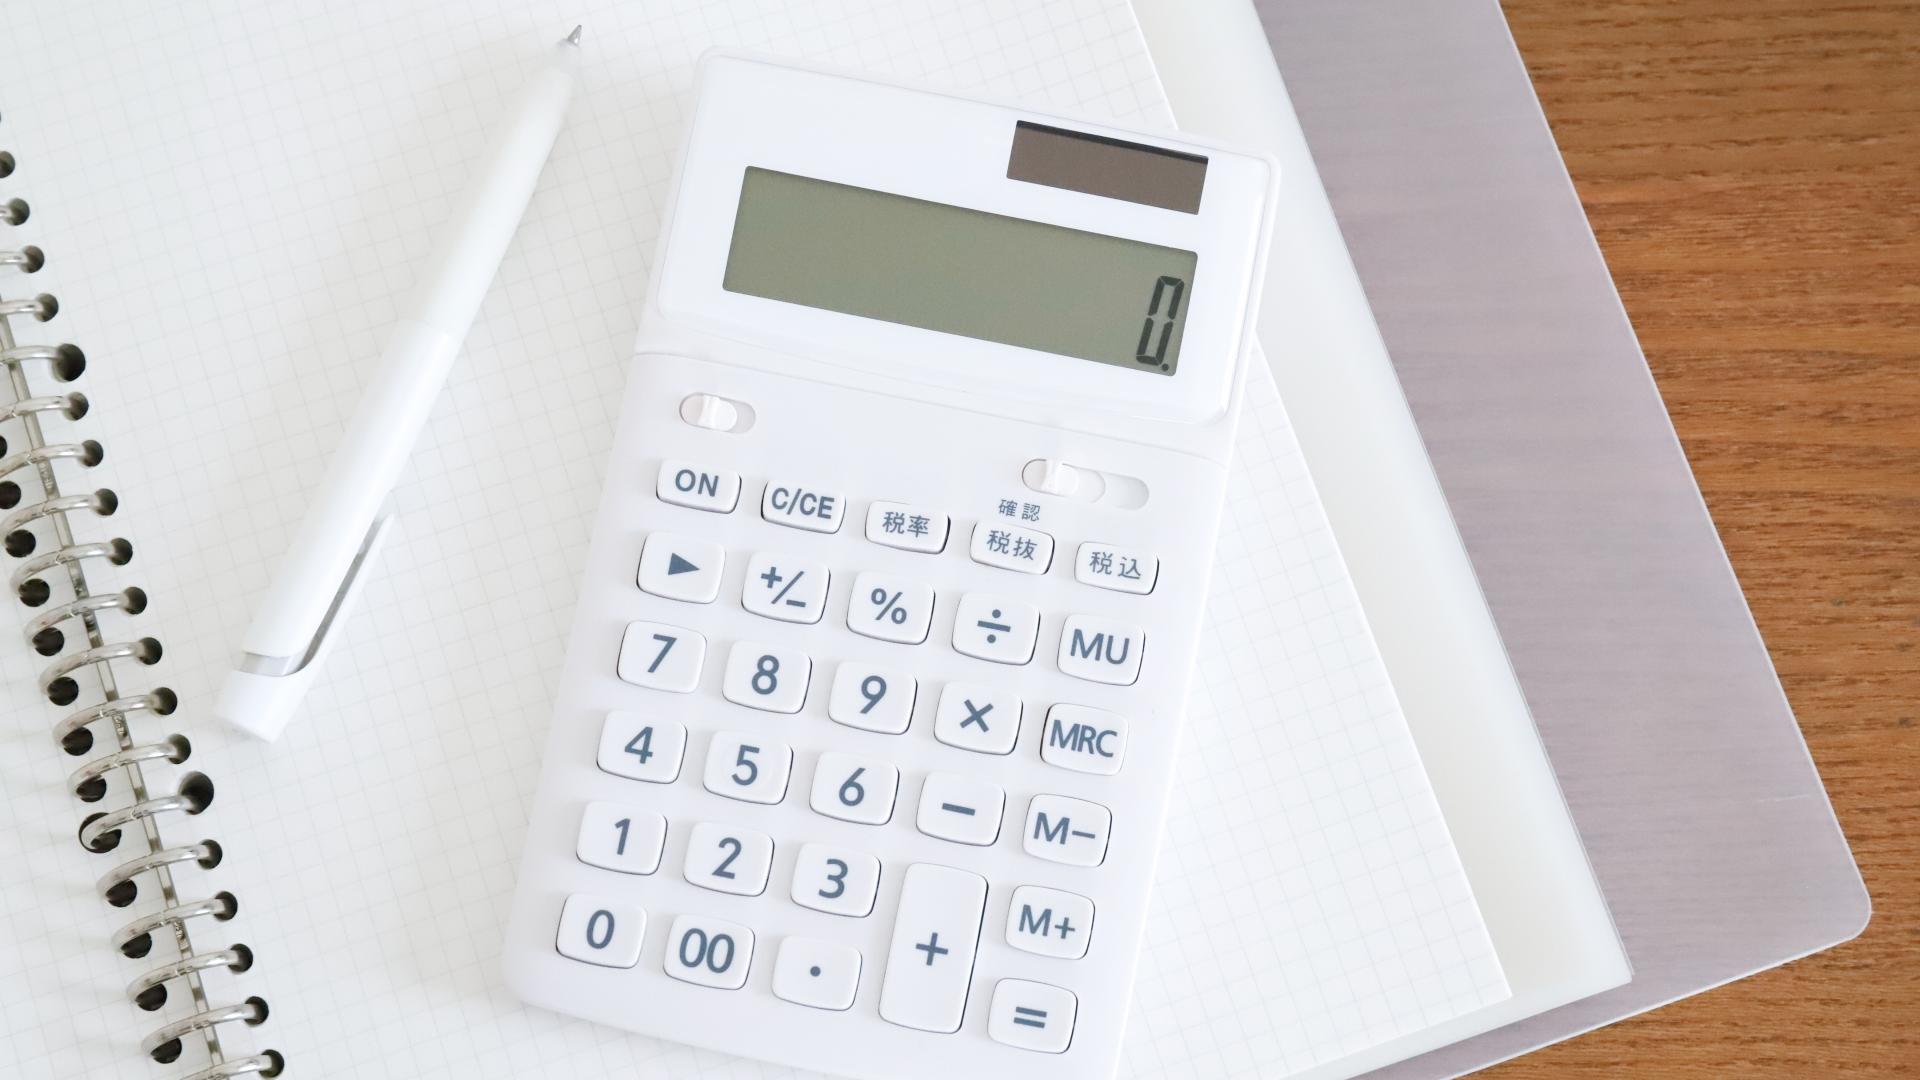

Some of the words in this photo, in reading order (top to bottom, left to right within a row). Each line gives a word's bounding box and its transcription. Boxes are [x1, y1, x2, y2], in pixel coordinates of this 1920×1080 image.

[675, 469, 719, 498] ON
[771, 487, 835, 520] C/CE
[999, 499, 1040, 521] 確認
[882, 511, 930, 538] 税率
[986, 530, 1037, 561] 税抜
[1089, 551, 1141, 580] 税込
[871, 588, 907, 624] %
[648, 634, 678, 674] 7
[1070, 629, 1130, 664] MU
[752, 655, 779, 695] 8
[860, 675, 887, 714] 9
[624, 727, 653, 764] 4
[1050, 724, 1118, 759] MRC
[732, 744, 760, 786] 5
[839, 768, 866, 806] 6
[615, 818, 631, 855] 1
[712, 837, 742, 879] 2
[819, 859, 848, 899] 3
[586, 910, 615, 949] 0
[1019, 904, 1075, 939] M+
[679, 928, 734, 973] 00
[916, 932, 948, 966] +
[1014, 1007, 1047, 1028] =
